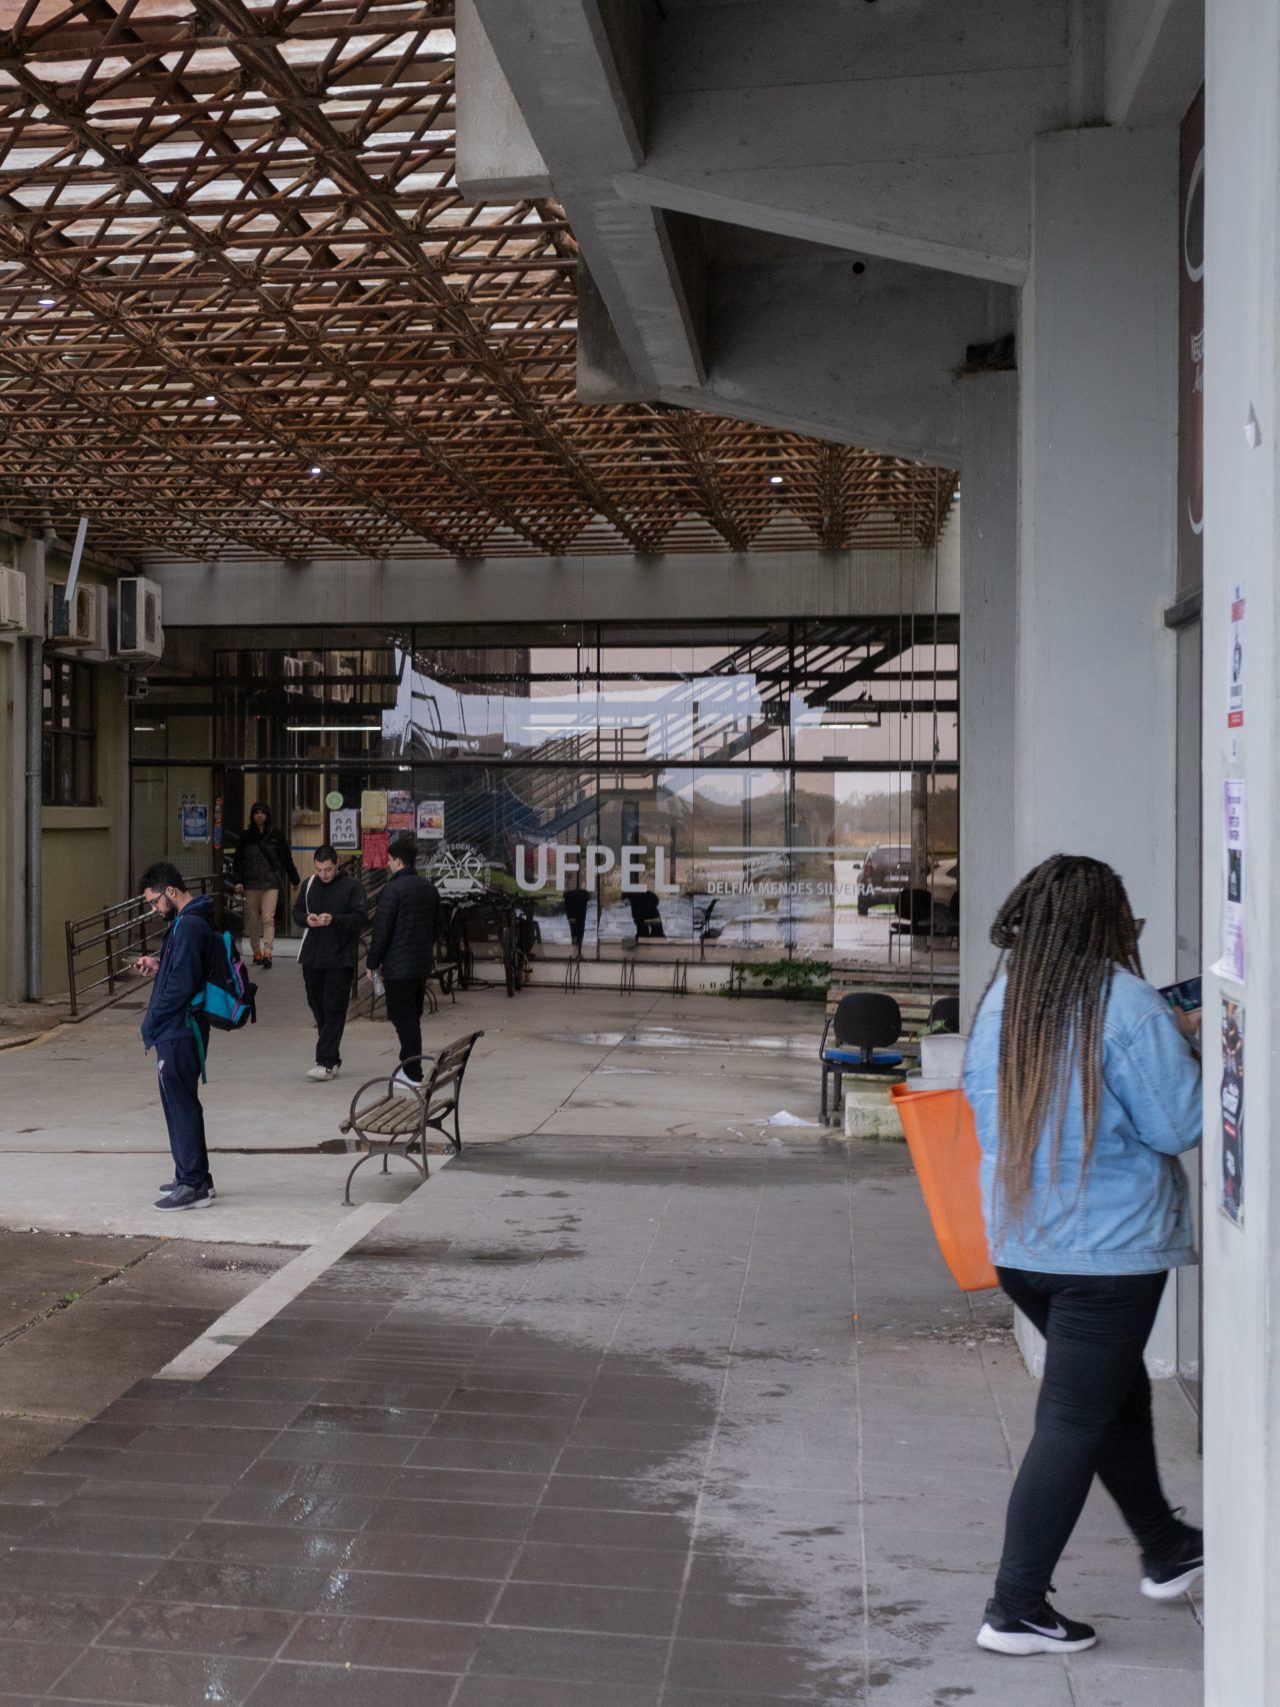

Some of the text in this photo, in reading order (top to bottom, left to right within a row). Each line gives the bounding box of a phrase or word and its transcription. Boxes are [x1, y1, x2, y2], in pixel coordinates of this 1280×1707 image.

[515, 844, 680, 893] UFPEL
[707, 881, 875, 896] DELFIM MENDES SILVEIRA
